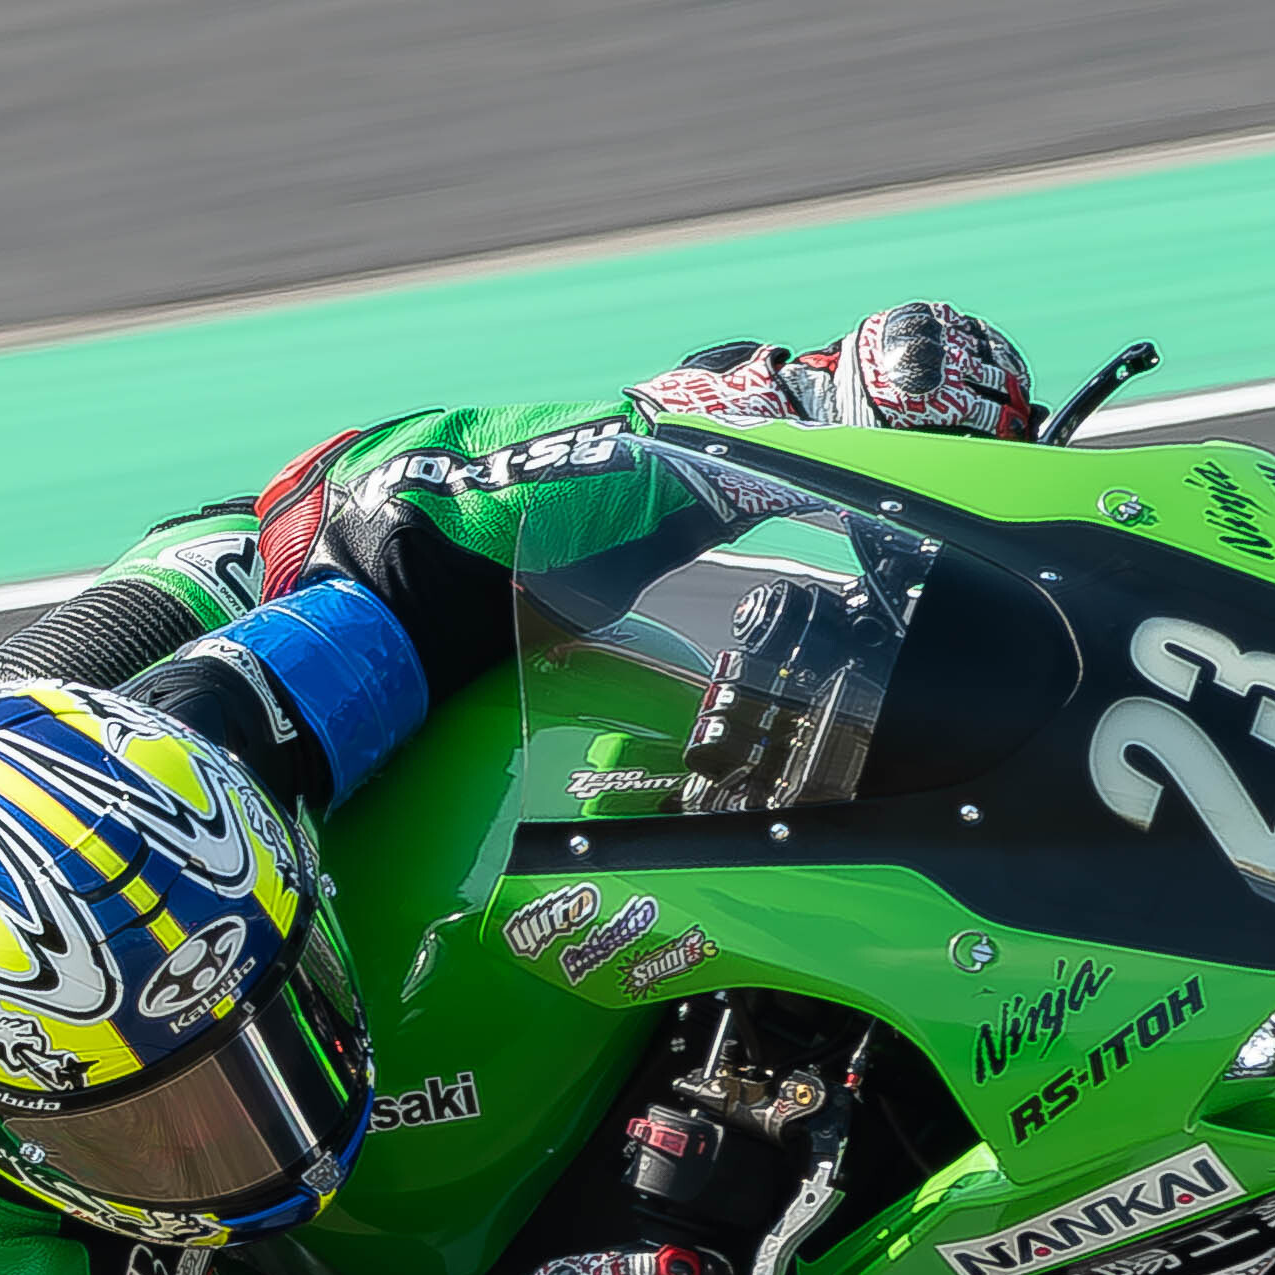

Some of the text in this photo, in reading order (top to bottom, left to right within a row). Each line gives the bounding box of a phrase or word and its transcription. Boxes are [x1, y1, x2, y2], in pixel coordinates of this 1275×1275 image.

[1184, 460, 1275, 562] Ninja
[567, 770, 644, 793] ZERO
[972, 958, 1114, 1085] Ninja
[1008, 975, 1206, 1146] RS-ITOH
[368, 1072, 480, 1135] saki
